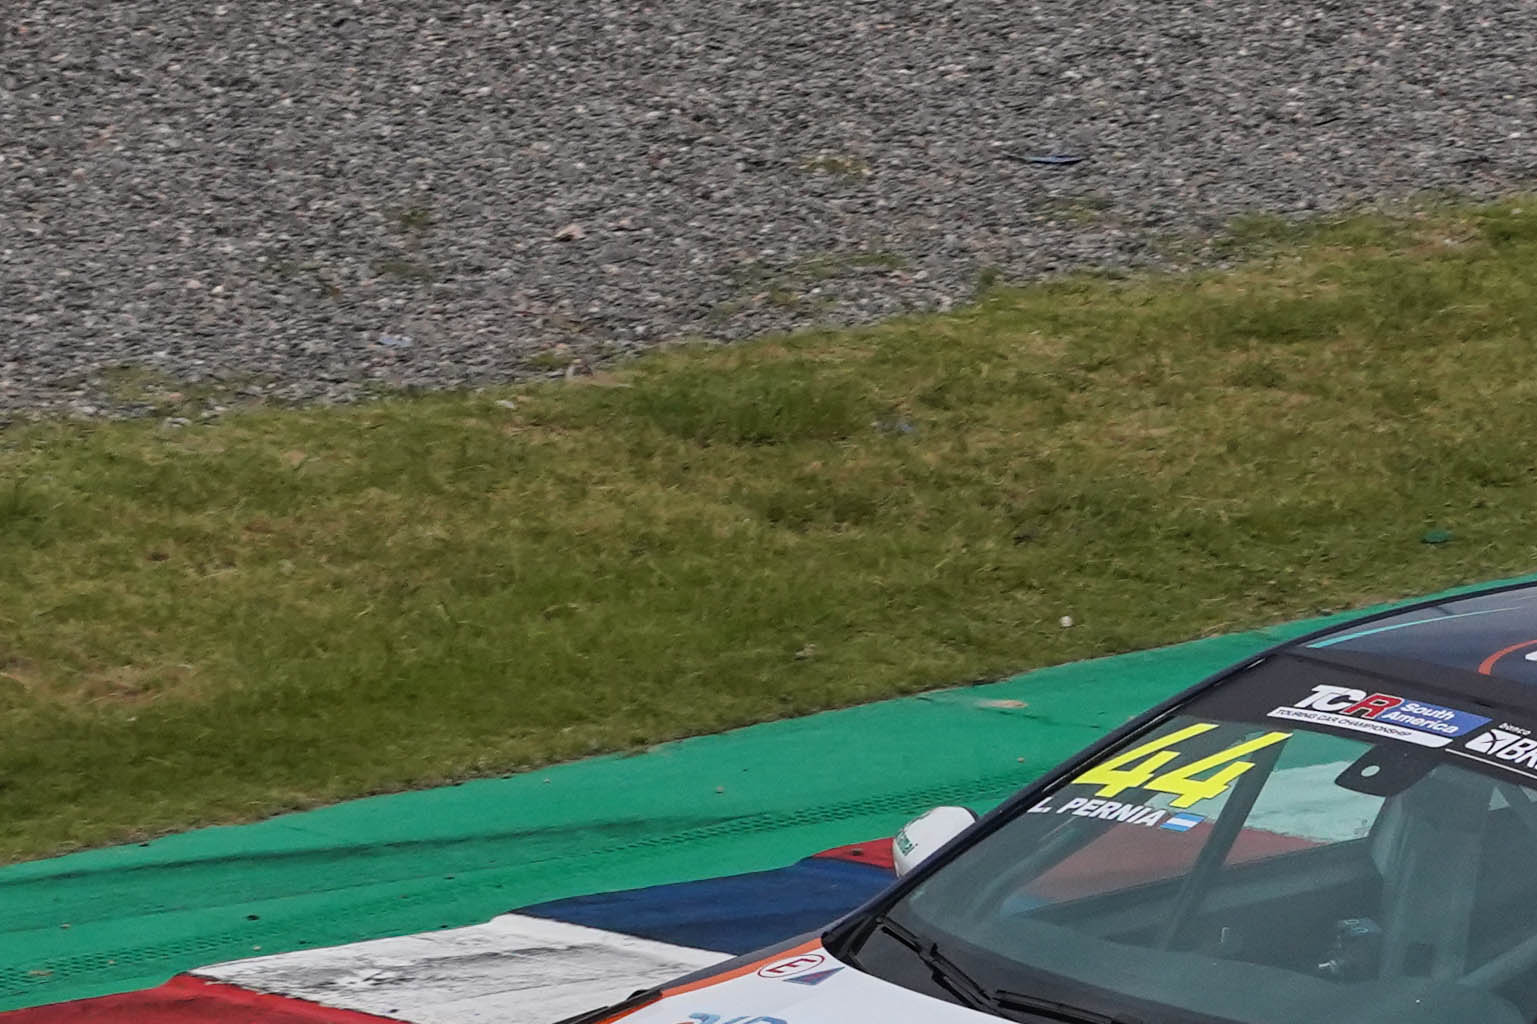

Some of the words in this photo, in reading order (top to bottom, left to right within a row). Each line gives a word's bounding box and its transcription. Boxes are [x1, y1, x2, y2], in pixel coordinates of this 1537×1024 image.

[1293, 684, 1404, 719] TCR
[1400, 702, 1456, 721] South
[1277, 708, 1318, 721] TOURING
[1317, 713, 1339, 723] CAR
[1338, 716, 1413, 737] CHAMPIONSHIP
[1381, 711, 1460, 735] America
[1498, 722, 1532, 736] banco
[1071, 722, 1294, 809] 44
[1027, 796, 1053, 814] L.
[1056, 798, 1168, 827] PERNIA
